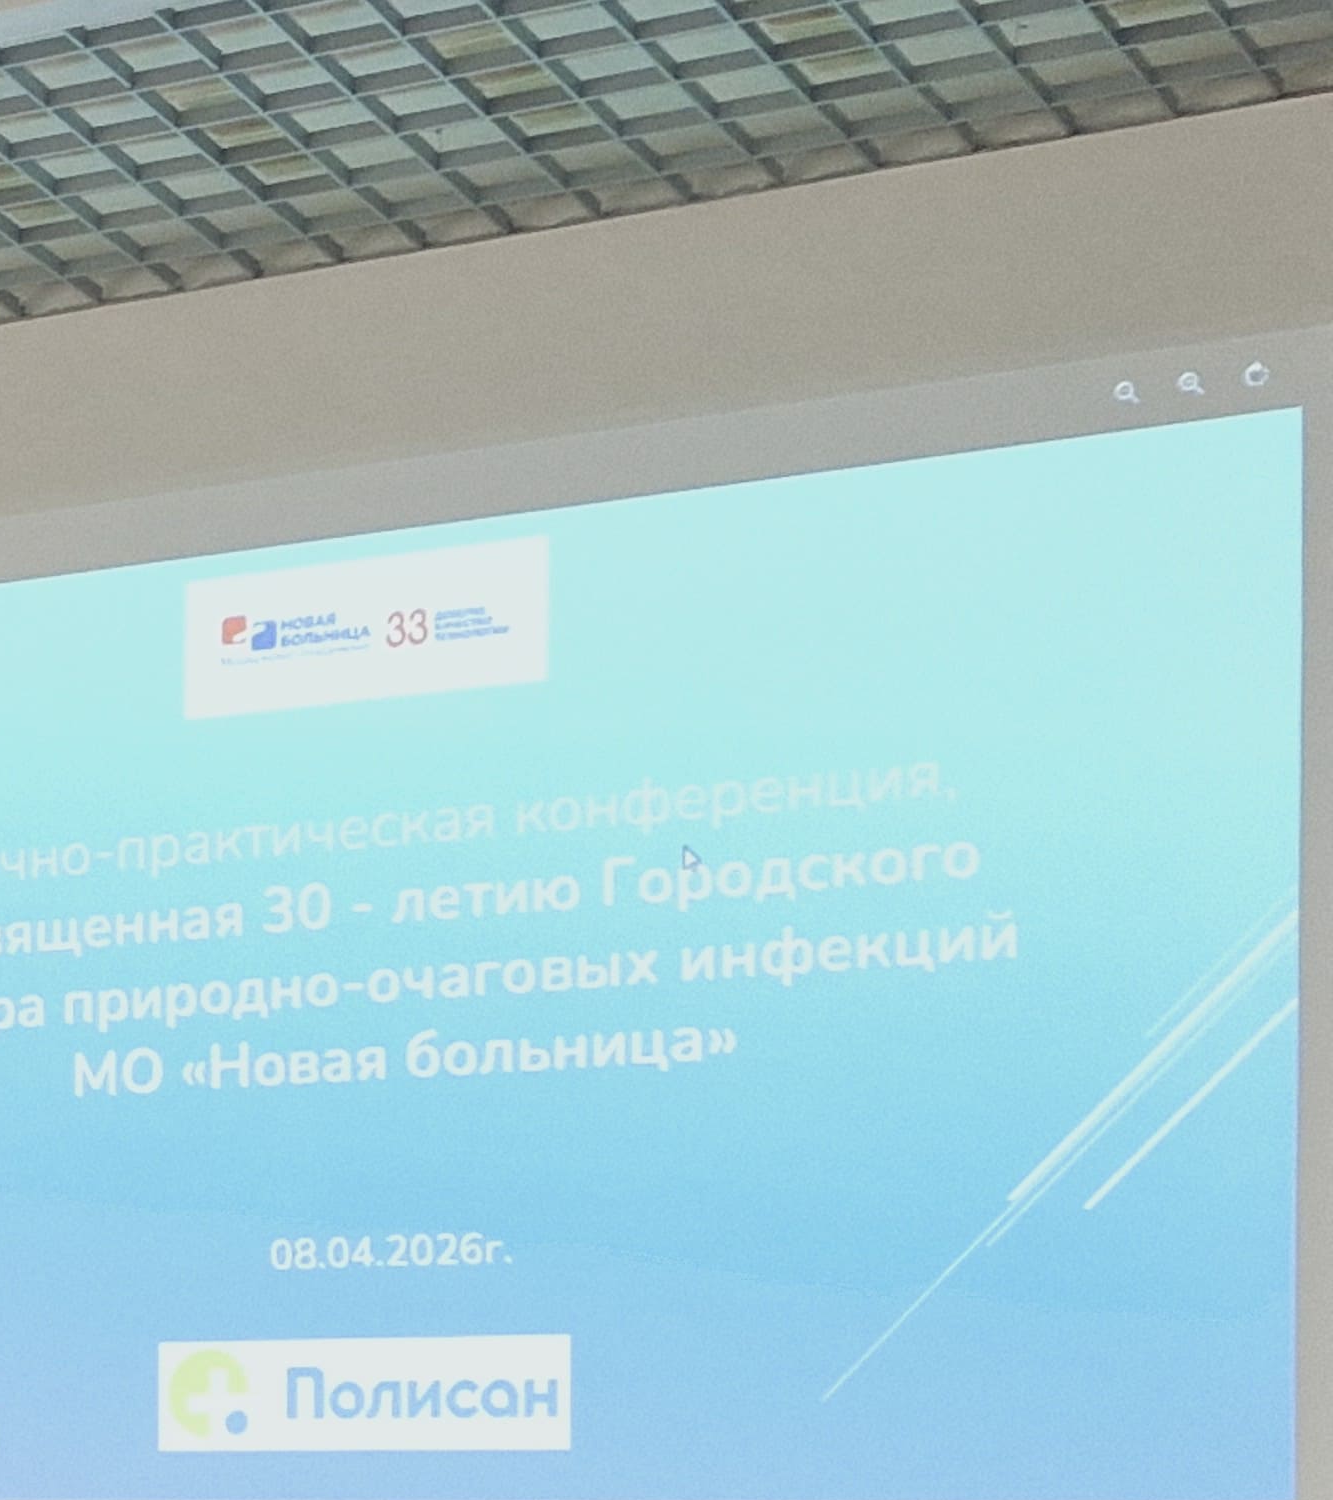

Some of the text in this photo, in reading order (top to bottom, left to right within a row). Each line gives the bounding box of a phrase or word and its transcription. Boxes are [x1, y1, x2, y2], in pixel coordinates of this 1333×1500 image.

[280, 612, 336, 630] НОВАЯ
[280, 626, 372, 648] БОЛЬНИЦА
[386, 608, 428, 648] 33
[516, 760, 957, 833] конференция,
[263, 882, 331, 934] 30
[392, 874, 581, 925] летию
[602, 841, 981, 912] Городского
[64, 949, 660, 1031] природно-очаговых
[681, 910, 1019, 988] инфекций
[74, 1026, 738, 1097] МО «Новая больница»
[269, 1232, 514, 1271] 08.04.2026г.
[286, 1367, 559, 1420] Полисан
